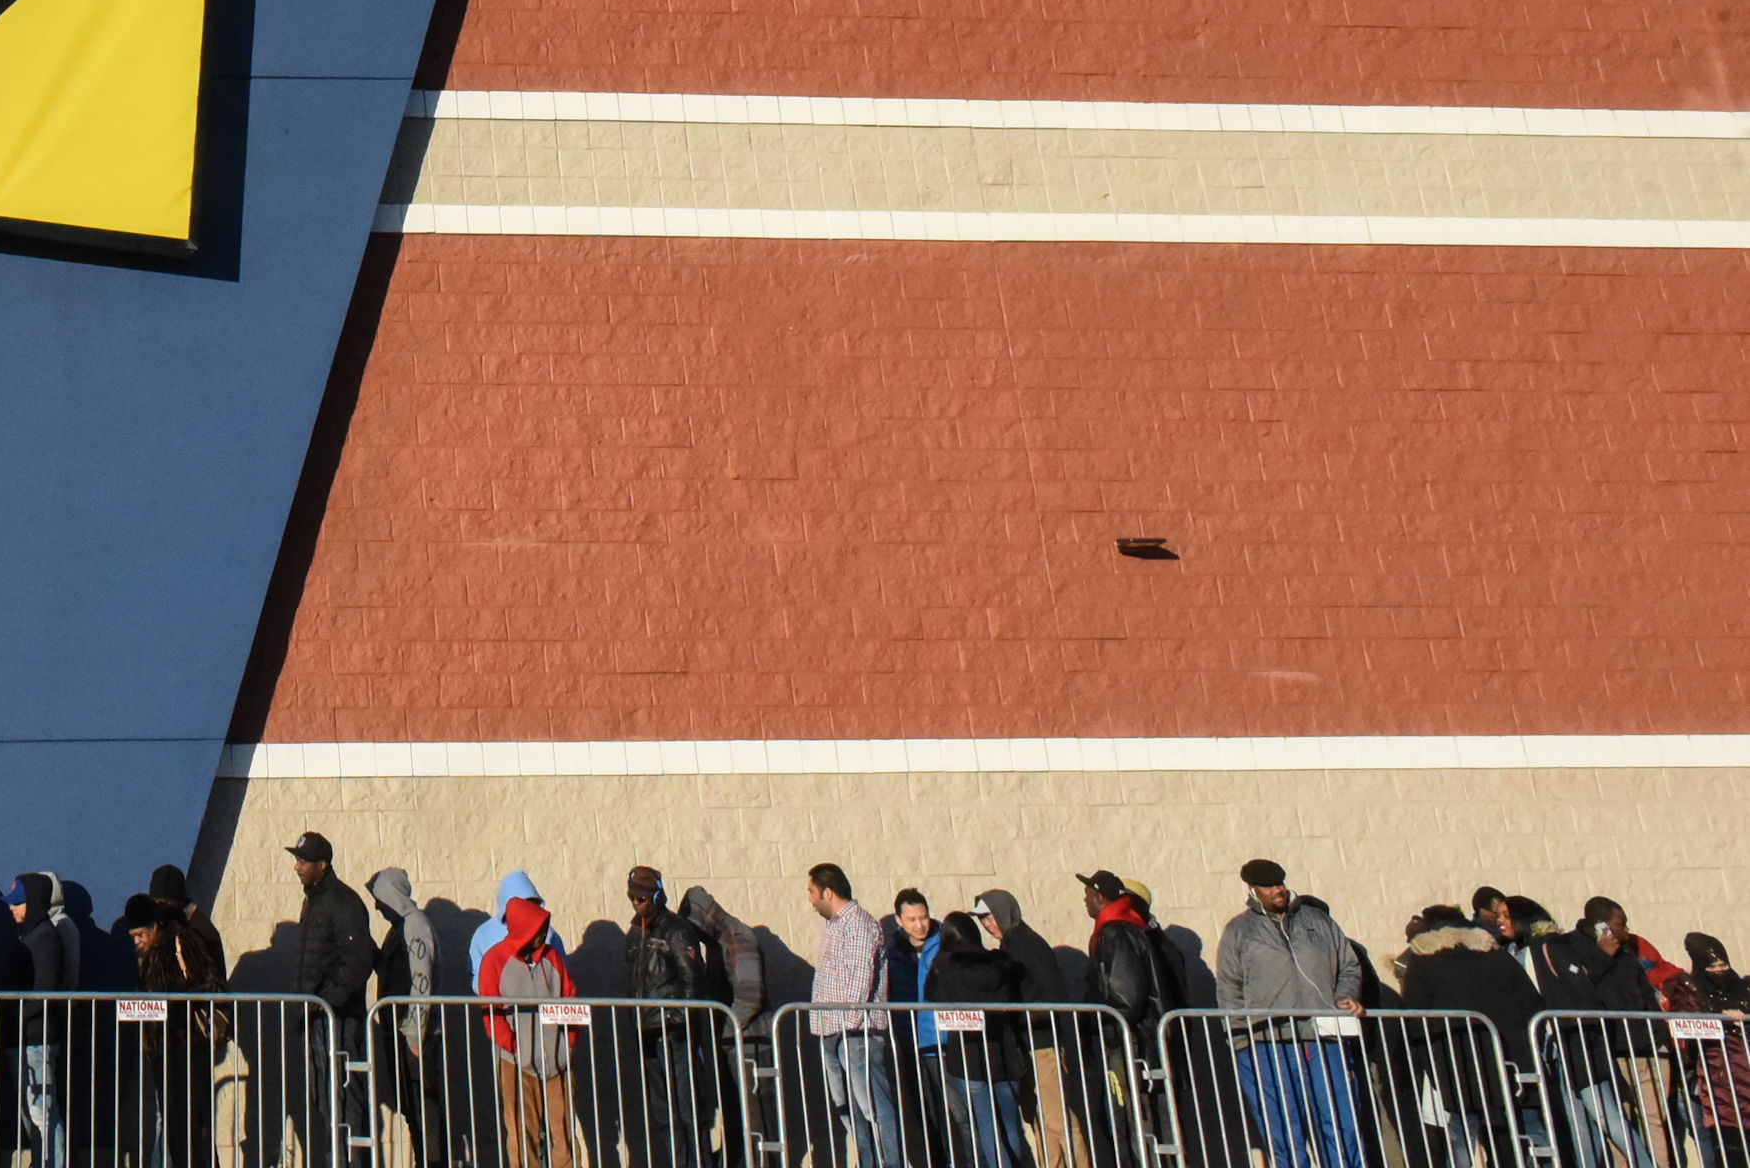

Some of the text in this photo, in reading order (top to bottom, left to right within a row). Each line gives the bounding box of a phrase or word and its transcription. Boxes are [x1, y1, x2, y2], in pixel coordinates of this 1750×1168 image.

[119, 1001, 165, 1011] NATIONAL
[542, 1005, 589, 1015] NATIONAL
[937, 1012, 983, 1022] NATIONAL
[1674, 1020, 1721, 1030] NATIONAL
